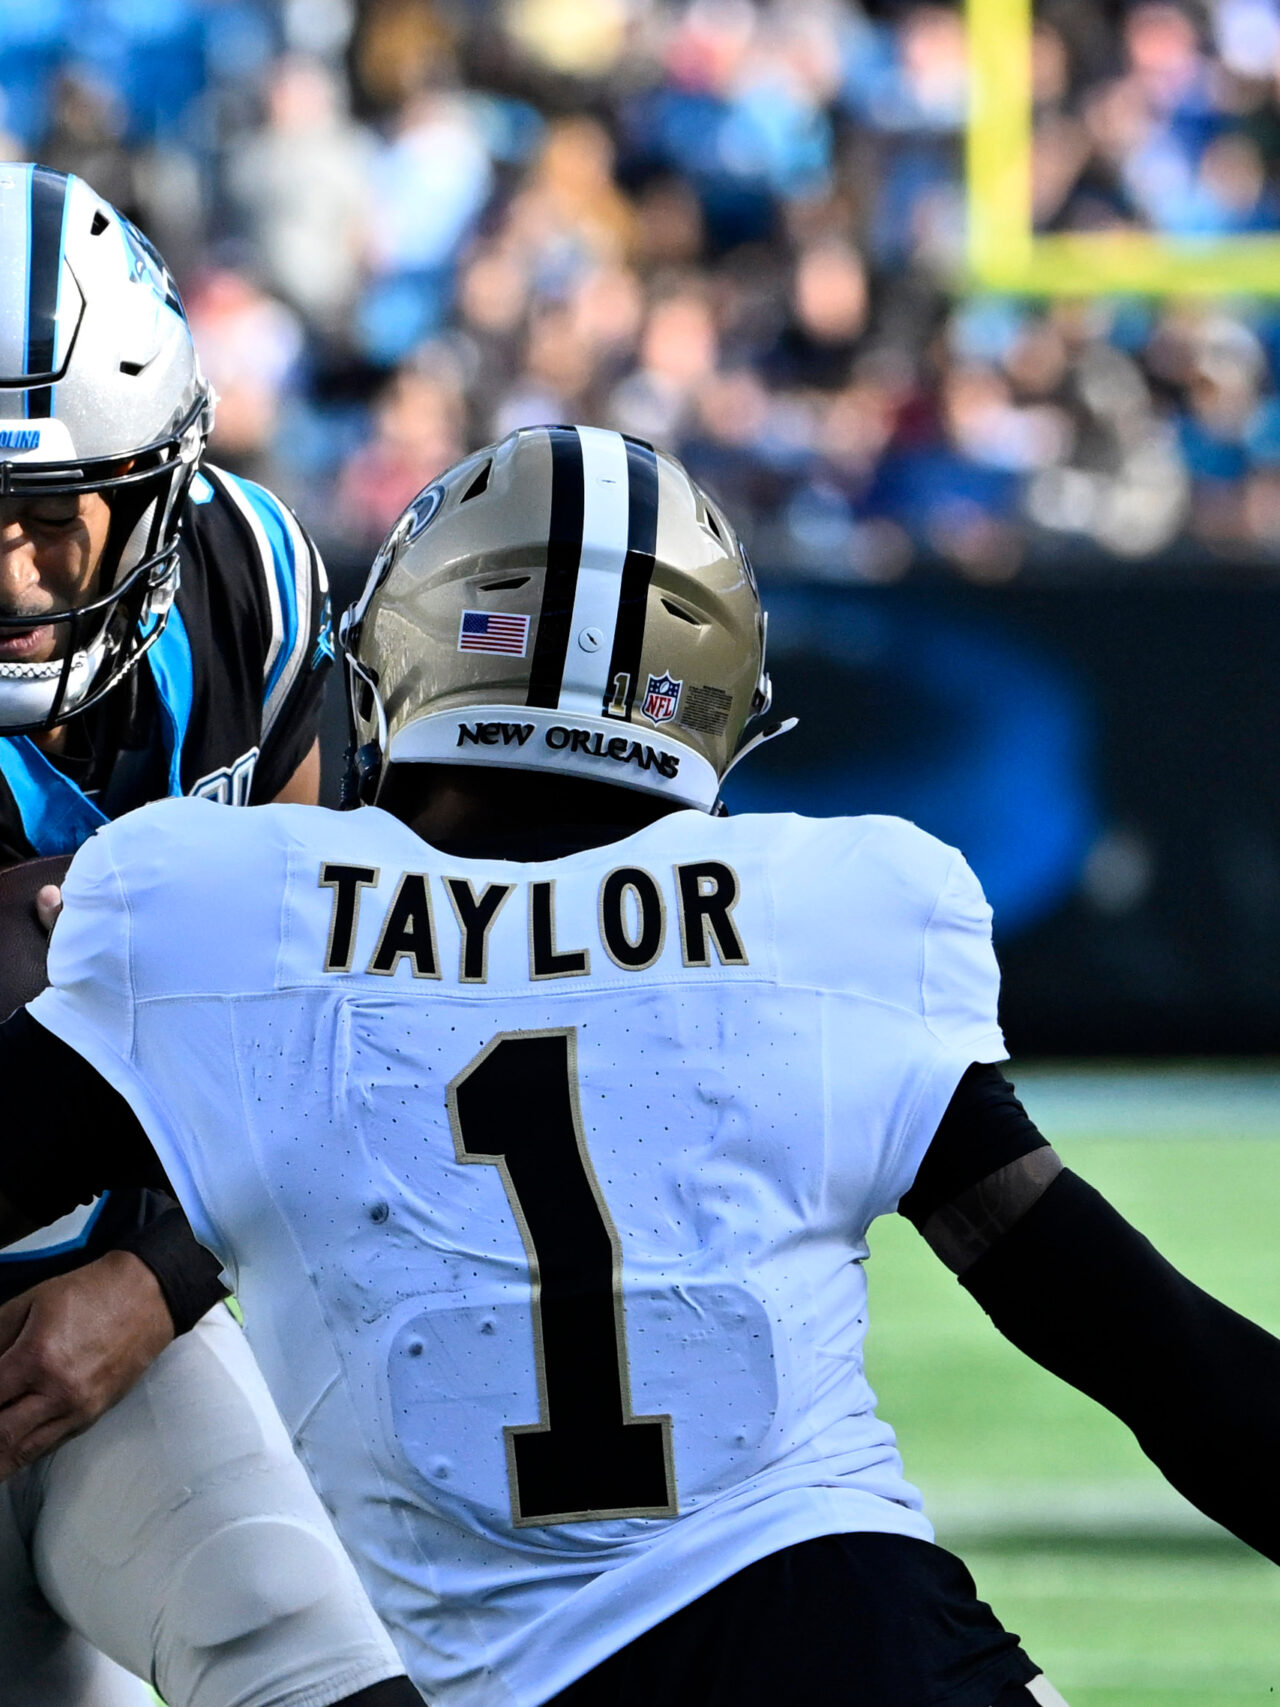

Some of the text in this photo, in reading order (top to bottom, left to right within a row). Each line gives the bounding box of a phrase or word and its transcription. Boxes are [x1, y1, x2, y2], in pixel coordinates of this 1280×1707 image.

[608, 672, 630, 717] 1
[645, 694, 674, 719] NFL
[319, 860, 748, 982] TAYLOR
[445, 1027, 678, 1526] 1
